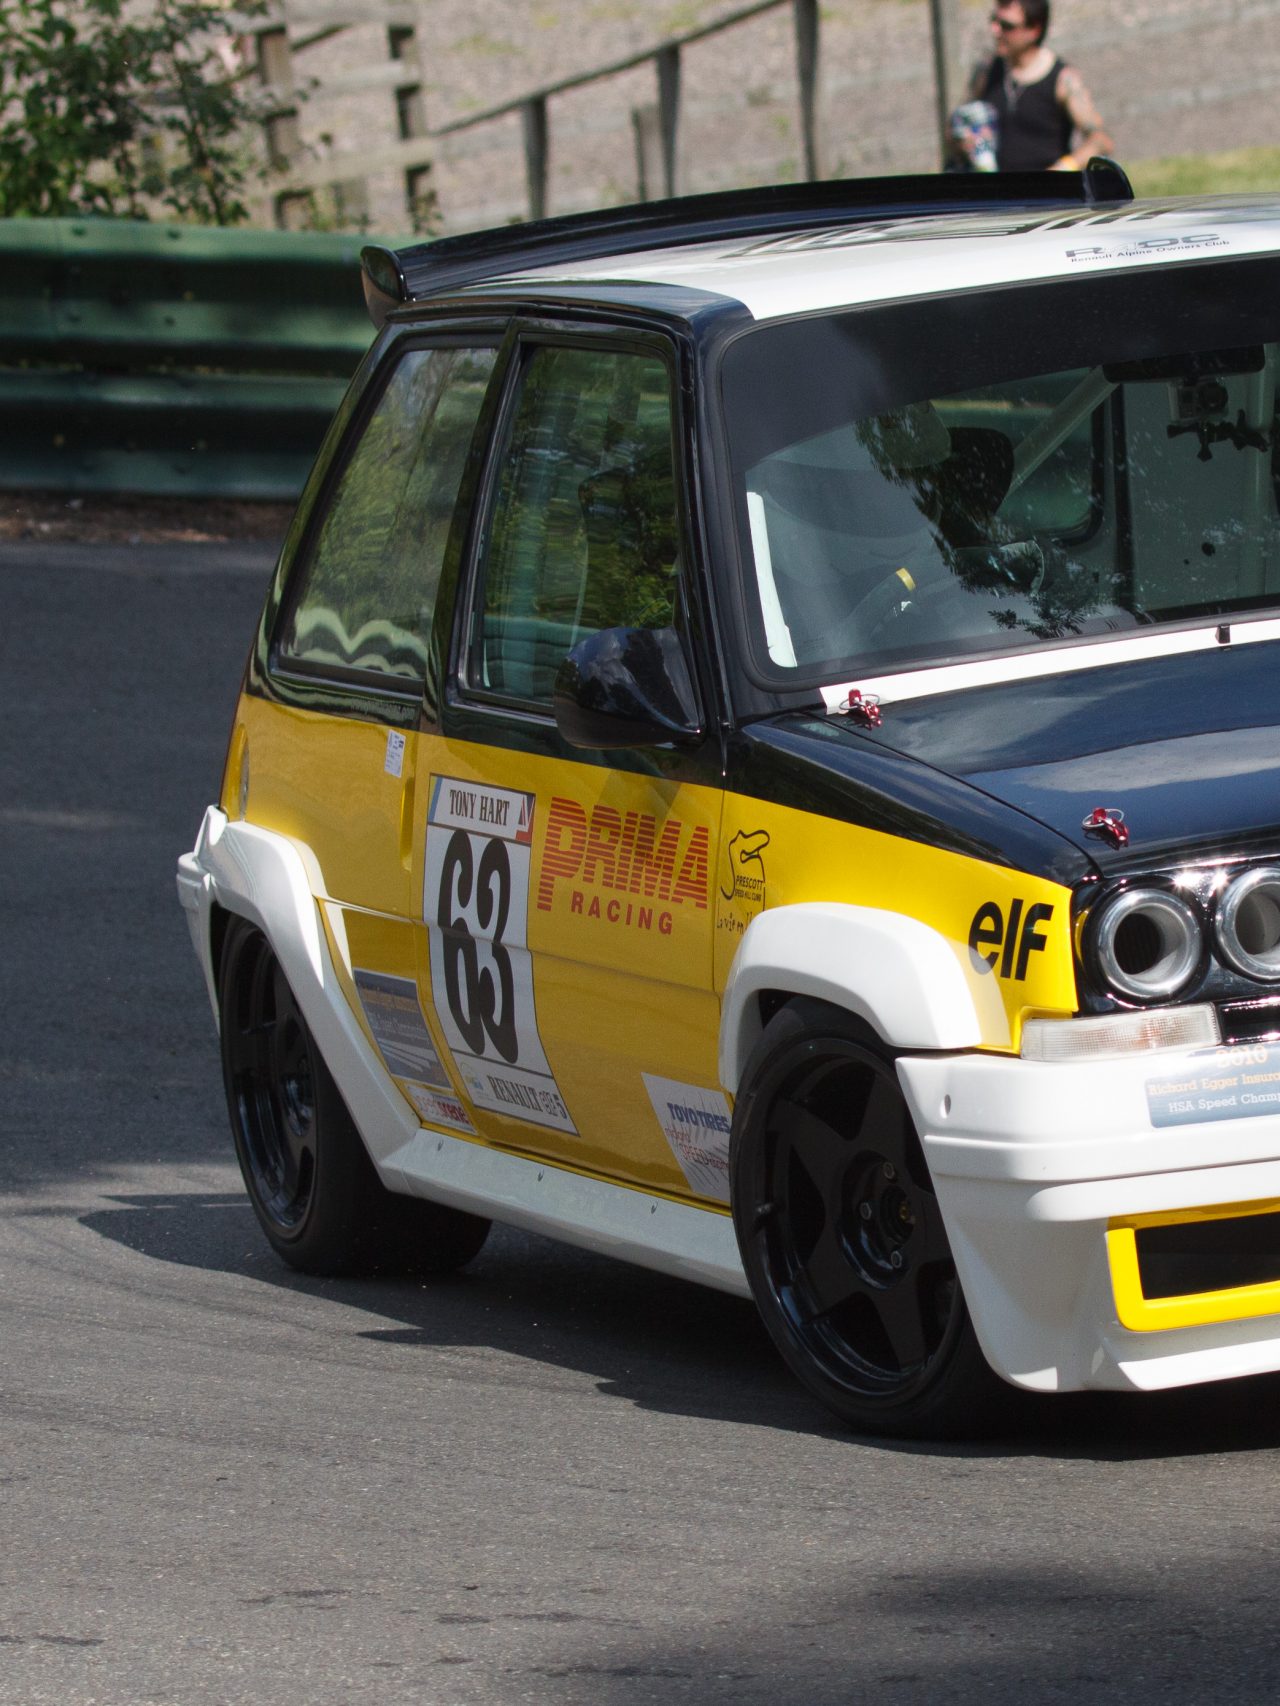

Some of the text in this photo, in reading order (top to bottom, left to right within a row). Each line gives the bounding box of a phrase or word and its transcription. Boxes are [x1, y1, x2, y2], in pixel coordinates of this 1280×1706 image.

[1065, 233, 1220, 257] ROC
[1117, 248, 1152, 257] Alpine
[1156, 243, 1200, 253] Owners
[1205, 240, 1230, 248] Club
[450, 789, 510, 826] TONY HART
[537, 797, 709, 911] PRIMA
[736, 875, 764, 891] PRESCOTT
[571, 891, 673, 935] RACING
[438, 829, 518, 1064] 63
[968, 898, 1054, 981] elf
[1215, 1044, 1268, 1067] 2010
[487, 1075, 543, 1112] RENAULT
[1148, 1079, 1197, 1095] Richard
[1202, 1076, 1238, 1091] Egger
[667, 1102, 732, 1134] TOYO TIRES
[1168, 1101, 1195, 1113] HSA
[1199, 1096, 1237, 1110] Speed
